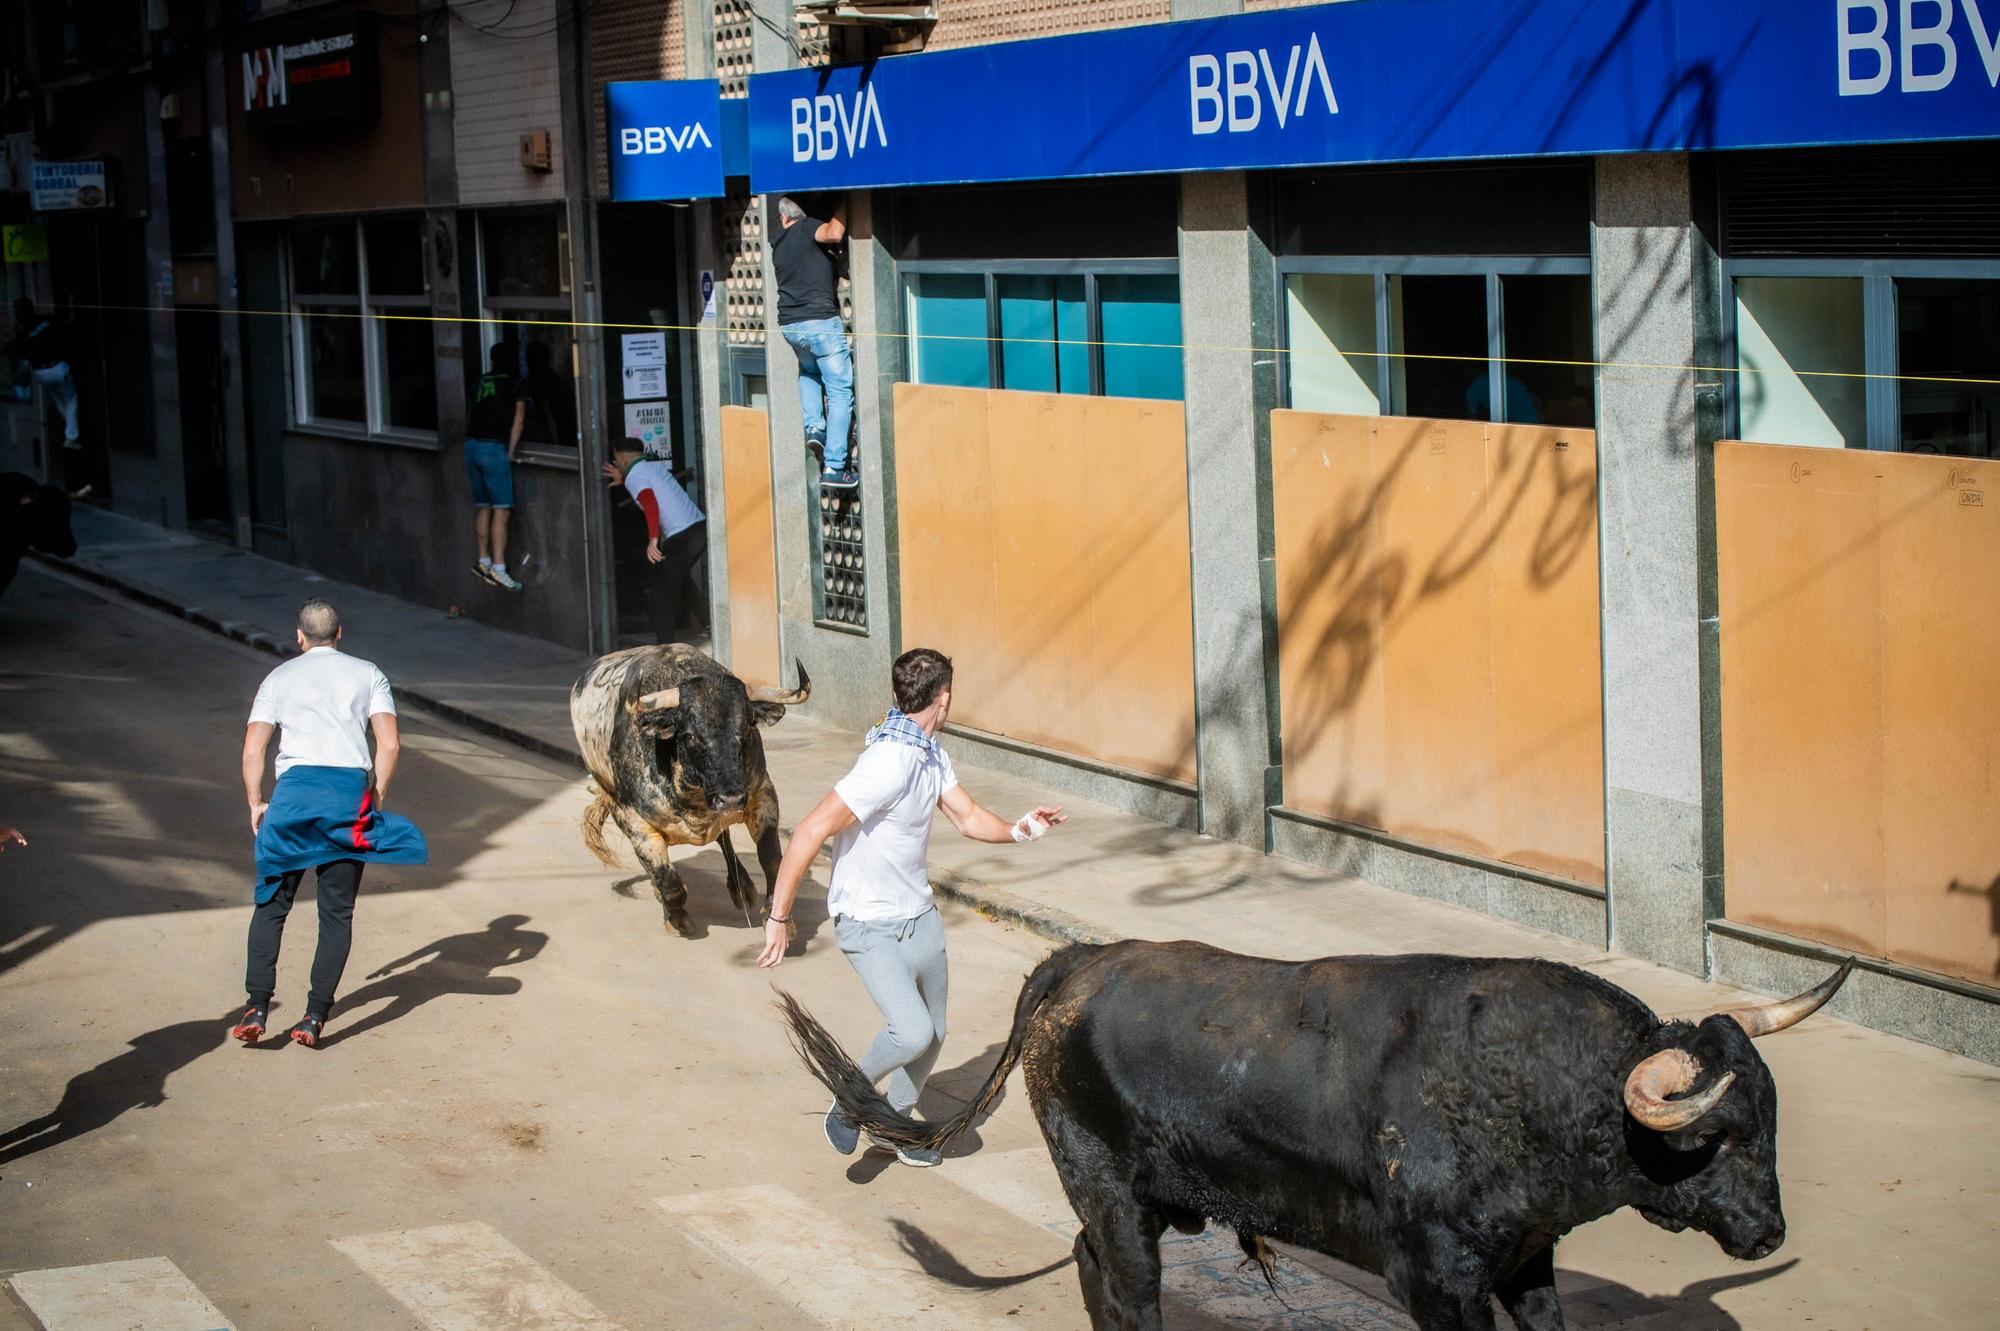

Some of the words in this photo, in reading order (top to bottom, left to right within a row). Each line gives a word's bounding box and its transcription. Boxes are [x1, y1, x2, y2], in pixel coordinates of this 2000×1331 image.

[1189, 31, 1339, 135] BBVA
[621, 122, 712, 155] BBVA
[791, 81, 888, 162] BBVA
[35, 177, 79, 190] BOREAL
